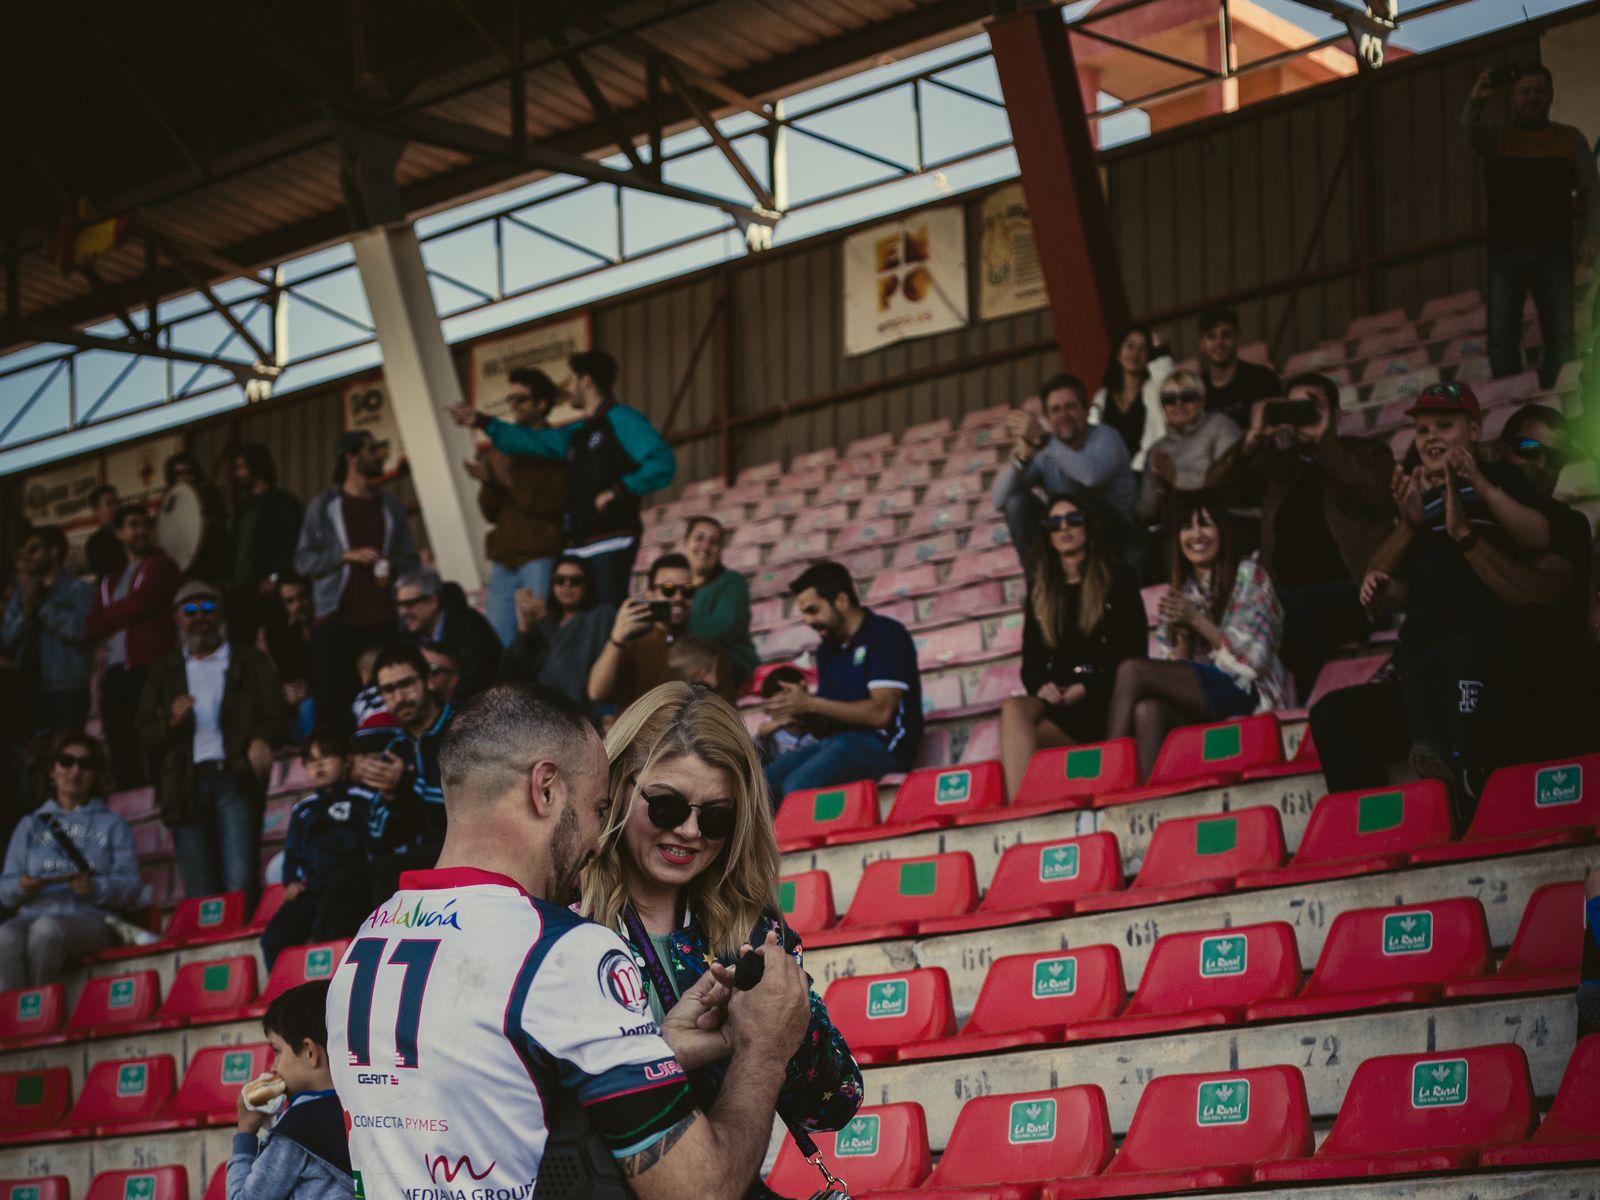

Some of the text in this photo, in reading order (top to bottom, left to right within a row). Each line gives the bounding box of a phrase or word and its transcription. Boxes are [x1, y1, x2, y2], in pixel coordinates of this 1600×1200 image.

[368, 896, 462, 931] Andalucía
[345, 937, 442, 1068] 11
[357, 1073, 389, 1085] GERIT
[1419, 1084, 1460, 1097] La Rural
[1203, 1103, 1241, 1116] La Rural
[353, 1115, 449, 1133] CONECTAPYMES
[1015, 1121, 1050, 1135] La Rural
